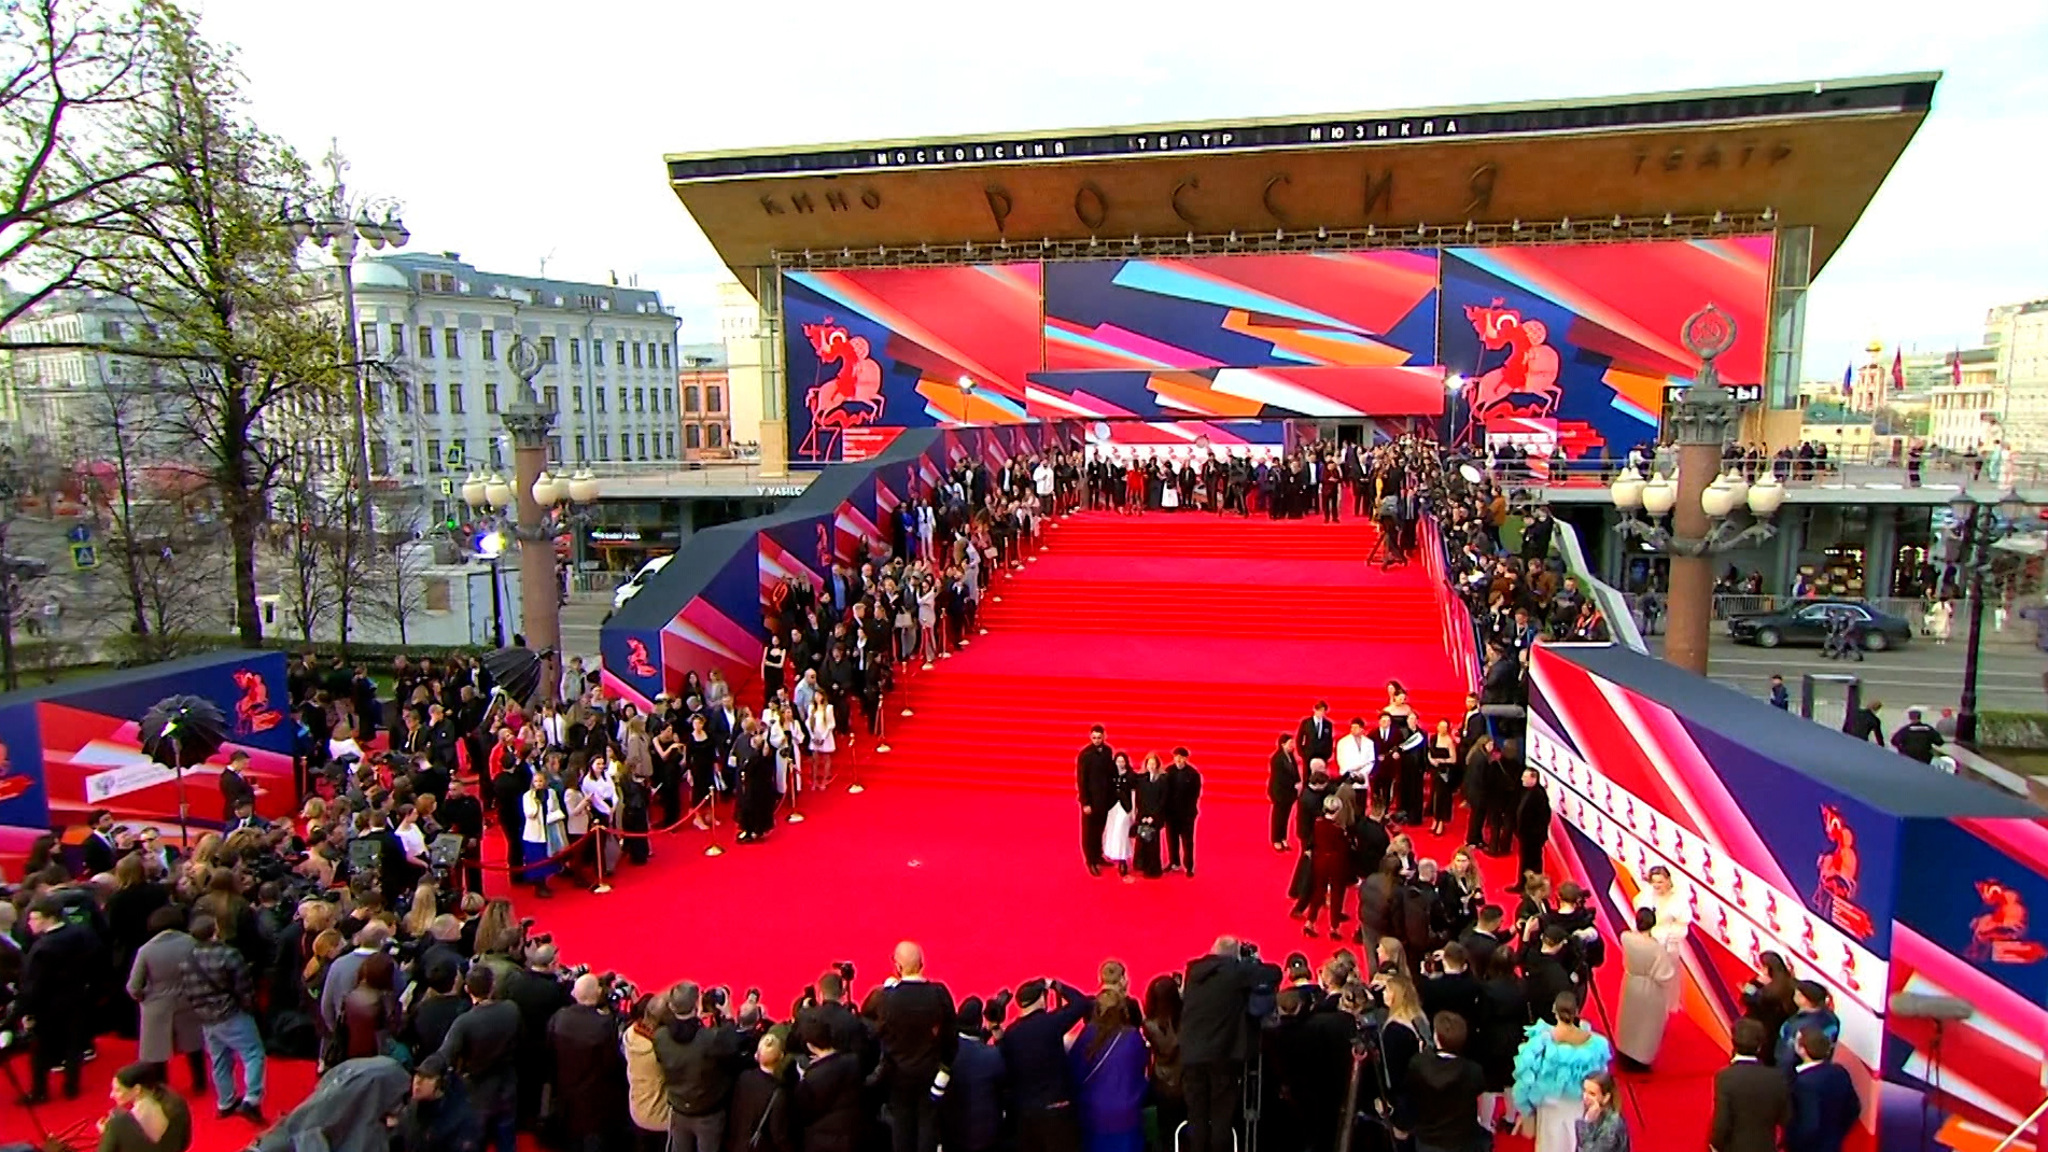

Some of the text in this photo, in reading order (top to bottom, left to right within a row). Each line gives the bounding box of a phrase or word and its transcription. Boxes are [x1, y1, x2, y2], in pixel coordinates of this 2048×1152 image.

[877, 120, 1458, 165] МОСКОВСКИЙ ТЕАТР МЮЗИКЛА
[759, 187, 881, 216] КИНО
[983, 161, 1498, 233] РОССИЯ
